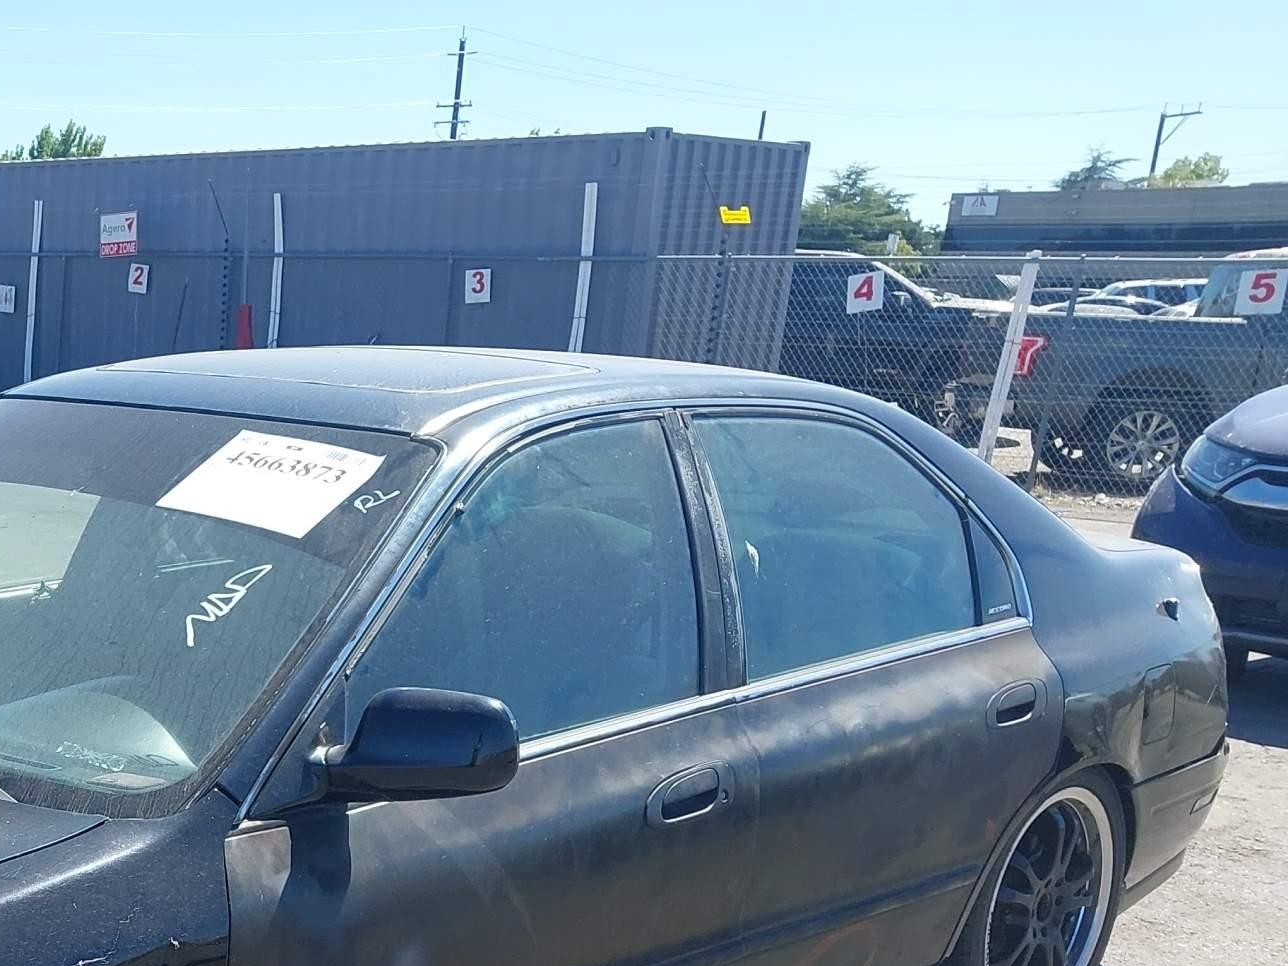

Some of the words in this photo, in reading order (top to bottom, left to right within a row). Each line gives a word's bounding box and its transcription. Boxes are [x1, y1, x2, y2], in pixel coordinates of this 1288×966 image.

[103, 224, 125, 236] Agero
[101, 244, 118, 255] DROP
[119, 242, 136, 253] ZONE
[132, 266, 145, 286] 2
[471, 271, 485, 294] 3
[1248, 272, 1277, 303] 5
[854, 275, 874, 301] 4
[226, 451, 347, 483] 45663873
